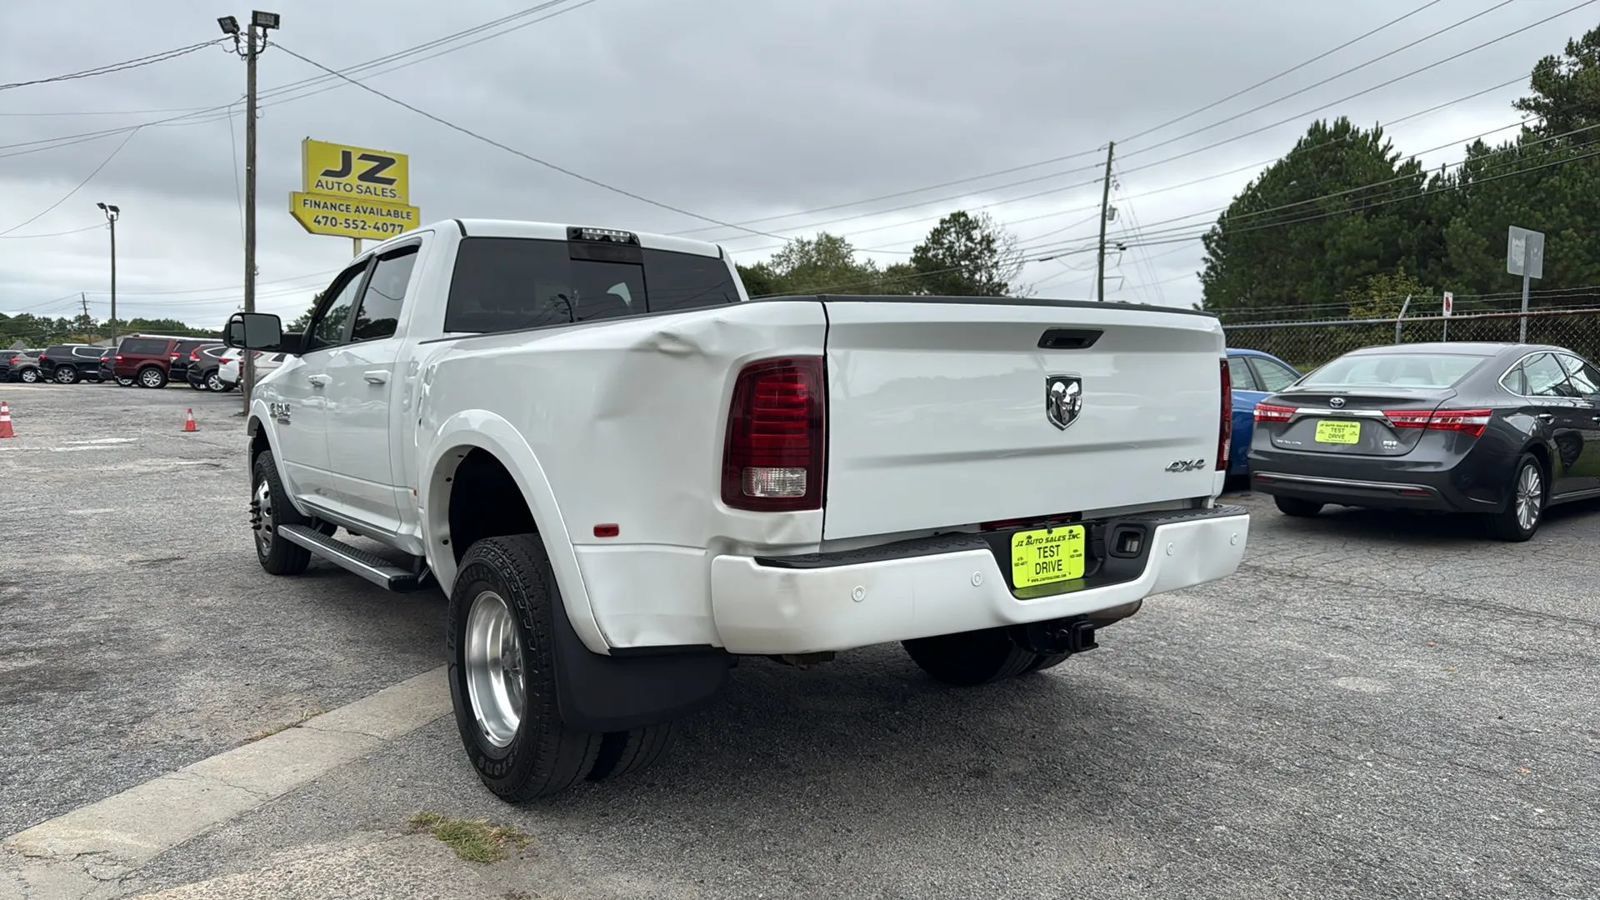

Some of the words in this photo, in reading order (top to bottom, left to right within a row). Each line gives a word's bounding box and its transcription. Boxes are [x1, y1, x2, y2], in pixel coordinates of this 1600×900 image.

[320, 150, 397, 186] JZ
[315, 179, 354, 193] AUTO
[356, 184, 397, 199] SALES
[303, 199, 352, 213] FINANCE
[354, 205, 413, 221] AVAILABLE
[313, 215, 405, 234] 470-552-4077
[1025, 537, 1044, 546] AUTO
[1045, 534, 1066, 543] SALES
[1037, 544, 1061, 559] TEST
[1035, 559, 1063, 575] DRIVE
